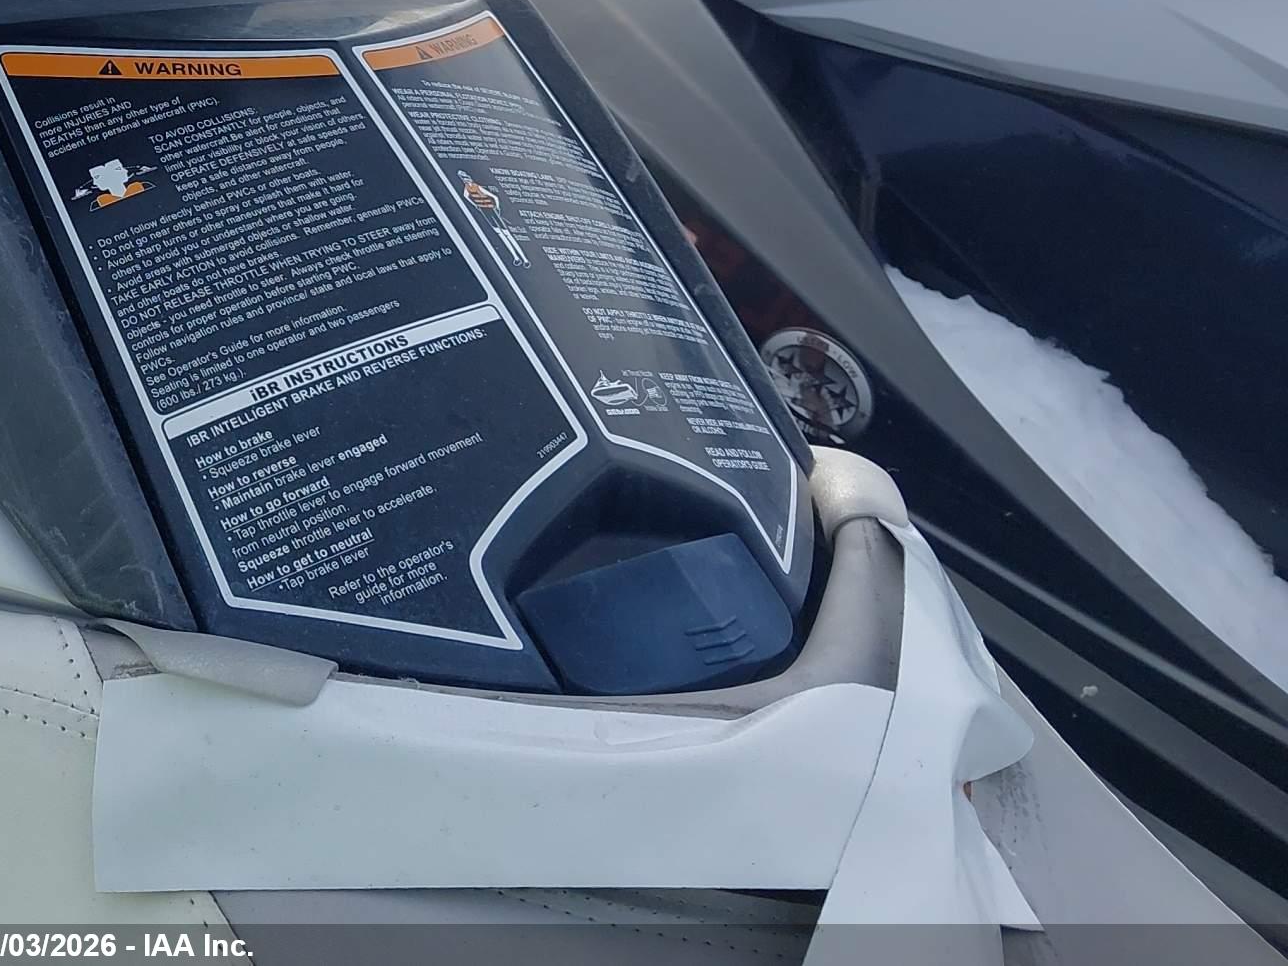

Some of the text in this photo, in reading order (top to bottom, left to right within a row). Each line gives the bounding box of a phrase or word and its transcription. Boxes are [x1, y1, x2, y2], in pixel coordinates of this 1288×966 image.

[134, 61, 242, 77] WARNING
[430, 34, 479, 55] WARNING
[34, 109, 78, 128] Collisions
[79, 99, 105, 113] result
[120, 216, 436, 328] DO NOT RELEASE THROTTLE WHEN TRYING TO STEER away from
[131, 261, 359, 350] controls for proper operation before starting PWC.
[135, 247, 452, 362] Follow navigation rules and province/ state and local laws that apply to
[140, 356, 175, 374] PWCs.
[145, 305, 346, 385] See Operator's Guide for more information.
[150, 300, 399, 397] Seating is limited to one operator and two passengers
[249, 335, 407, 401] iBR INSTRUCTIONS
[156, 394, 178, 411] (600
[202, 376, 222, 390] 273
[186, 328, 486, 447] IBR INTELLIGENT BRAKE AND REVERSE FUNCTIONS:
[195, 430, 272, 468] How to brake
[209, 426, 320, 478] Squeeze brake lever
[221, 433, 387, 509] Maintain brake lever engaged
[207, 456, 296, 498] How to reverse
[220, 475, 329, 529] How to go forward
[232, 432, 482, 539] Tap throttle lever to engage forward movement
[231, 504, 349, 558] from neutral position.
[237, 485, 436, 572] Squeeze throttle lever to accelerate.
[246, 527, 372, 588] How to get to neutral
[280, 547, 368, 590] Tap brake lever
[328, 540, 453, 598] Refer to the operator's
[355, 562, 436, 603] guide for more
[378, 573, 446, 604] information.
